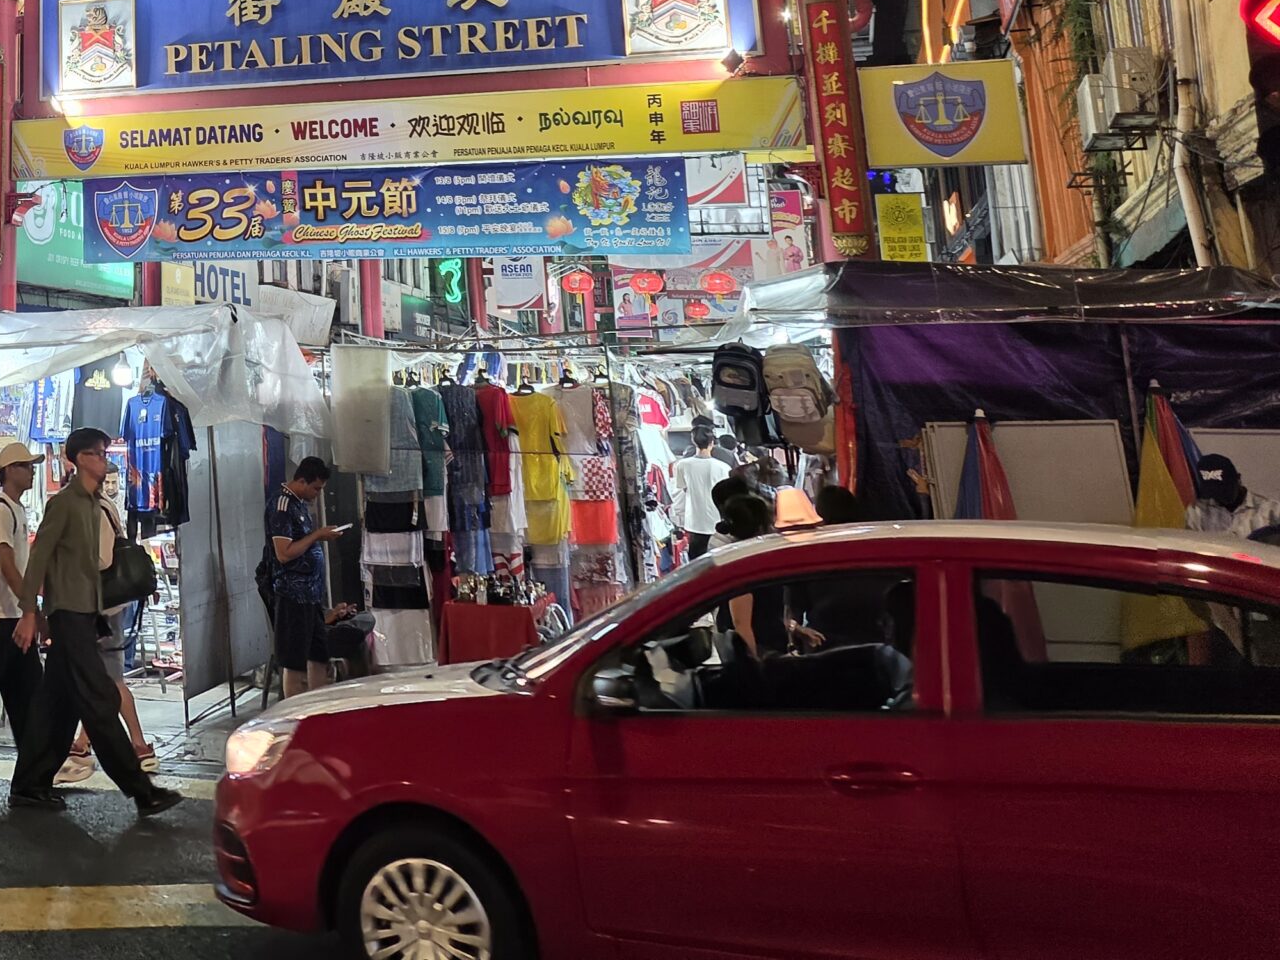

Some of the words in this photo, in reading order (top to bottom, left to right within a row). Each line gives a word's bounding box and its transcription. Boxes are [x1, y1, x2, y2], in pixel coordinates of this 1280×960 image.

[164, 30, 382, 76] PETALING
[396, 12, 589, 59] STREET
[407, 112, 507, 139] 欢迎观临
[537, 107, 625, 132] நல்வரவு
[646, 93, 667, 145] 丙申年
[120, 126, 192, 149] SELAMAT
[195, 122, 264, 146] DATANG
[291, 116, 380, 141] WELCOME
[124, 160, 148, 170] KUALA
[150, 159, 180, 169] LUMPUR
[182, 158, 220, 168] HAWKER'S
[222, 158, 228, 167] &
[230, 157, 253, 167] PETTY
[294, 153, 347, 164] ASSOCIATION
[454, 146, 487, 157] PERSATUAN
[487, 145, 513, 155] PENJAJA
[513, 144, 524, 154] DAN
[525, 143, 552, 154] PENIAGA
[553, 142, 568, 152] KECIL
[569, 142, 589, 152] KUALA
[590, 141, 615, 151] LUMPUR
[303, 178, 418, 222] 中元節
[293, 225, 337, 243] Chinese
[337, 224, 371, 244] Ghost
[370, 222, 422, 242] Festival
[173, 252, 208, 260] PERSATUAN
[210, 252, 235, 260] PENJAJA
[252, 251, 280, 259] PENIAGA
[281, 251, 299, 259] KECIL
[453, 247, 475, 255] PETTY
[513, 245, 561, 254] ASSOCIATION
[501, 264, 533, 274] ASEAN
[194, 261, 252, 307] HOTEL
